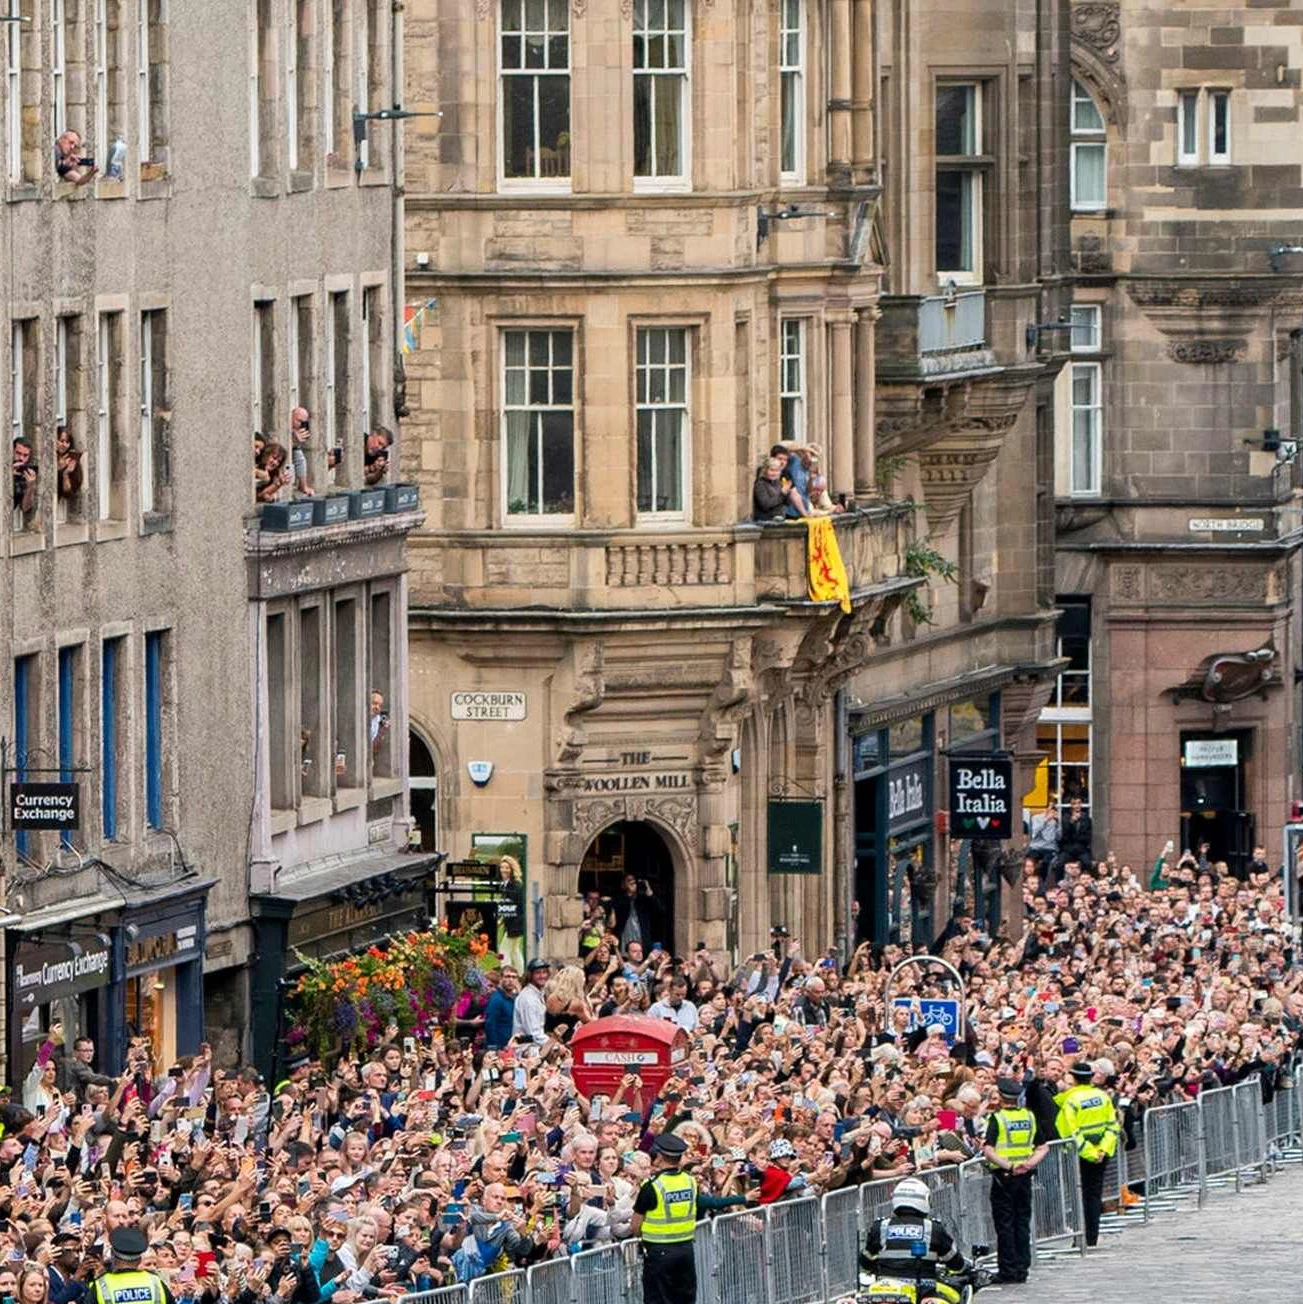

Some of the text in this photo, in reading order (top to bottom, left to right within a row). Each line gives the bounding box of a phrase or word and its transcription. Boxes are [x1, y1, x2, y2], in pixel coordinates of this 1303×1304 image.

[454, 694, 523, 706] COCKBURN
[466, 707, 510, 718] STREET
[620, 752, 652, 765] THE
[655, 775, 690, 788] MILL
[957, 769, 1006, 790] Bella
[16, 794, 73, 808] Currency
[956, 793, 1007, 814] Italia
[14, 807, 75, 821] Exchange
[42, 961, 74, 986] Currency
[74, 950, 108, 977] Exchange
[605, 1052, 634, 1062] CASH
[1008, 1121, 1031, 1130] POLICE
[666, 1190, 692, 1203] POLICE
[889, 1225, 923, 1238] POLICE
[115, 1288, 151, 1302] POLICE
